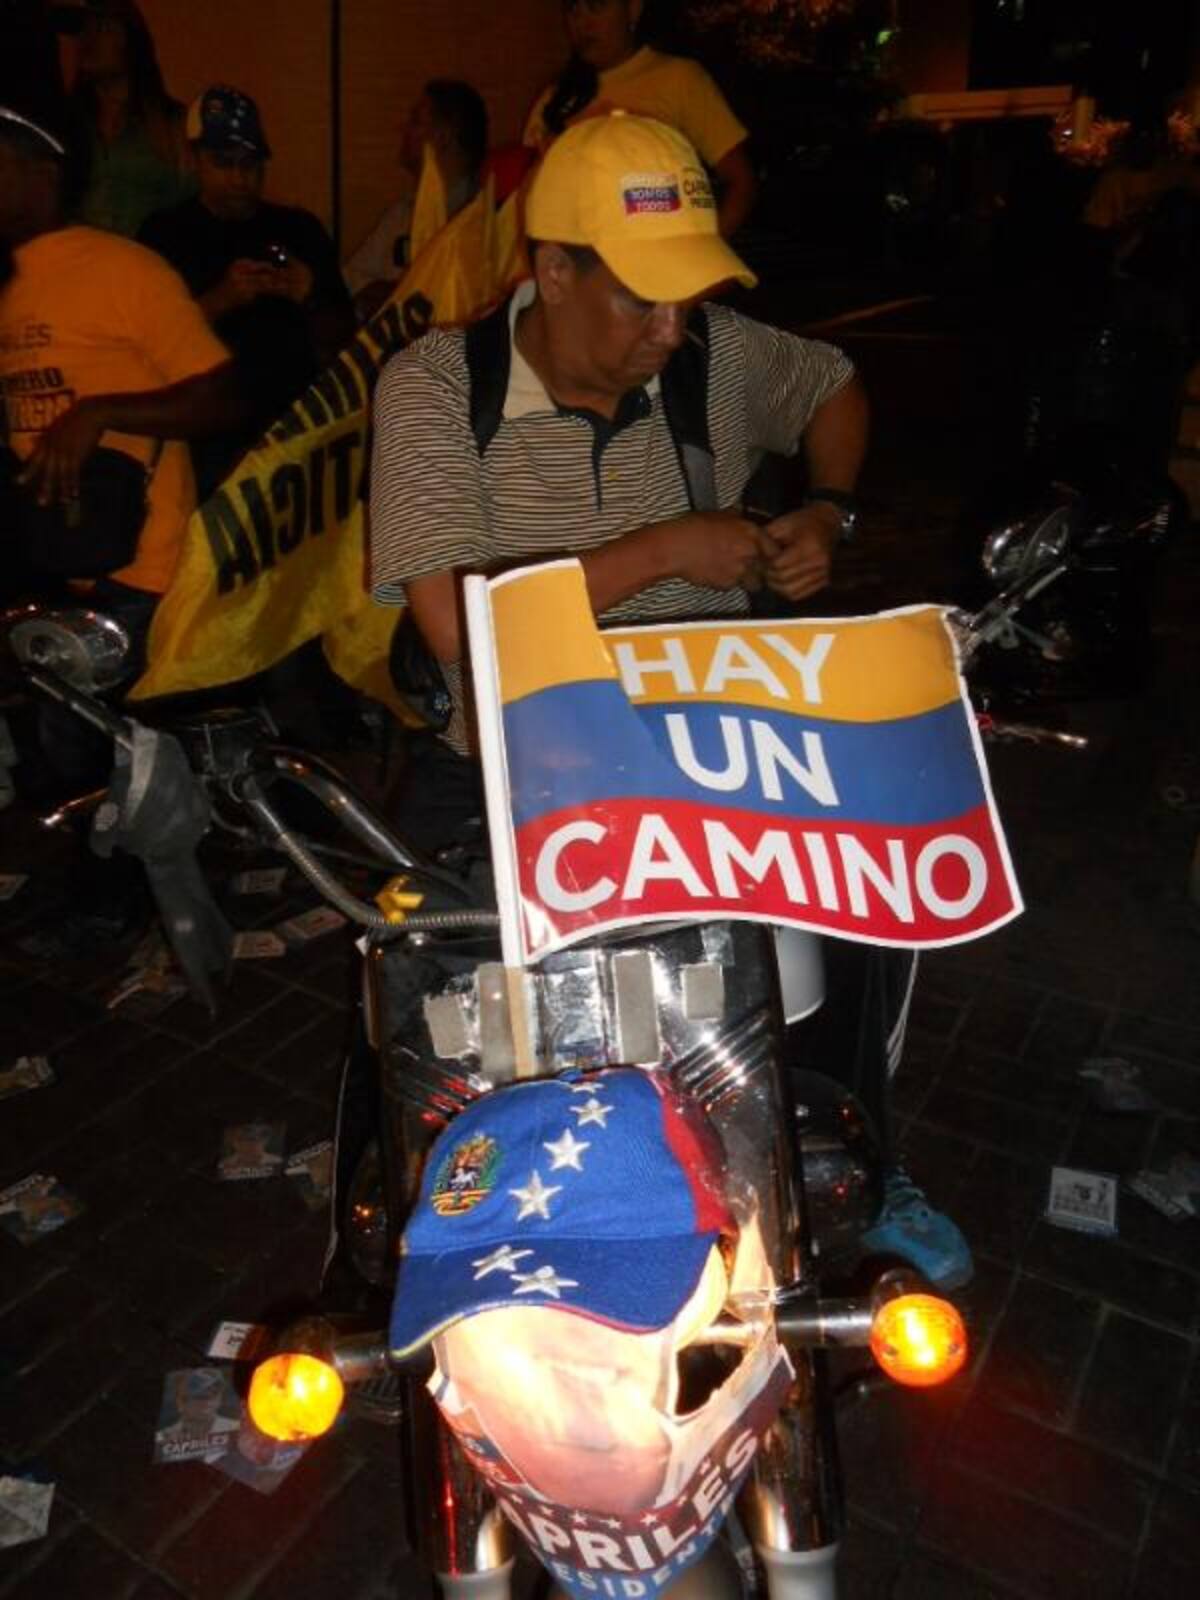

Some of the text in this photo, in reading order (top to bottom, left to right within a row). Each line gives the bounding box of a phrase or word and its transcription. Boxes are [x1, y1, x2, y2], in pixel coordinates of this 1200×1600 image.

[613, 633, 837, 704] HAY
[664, 713, 840, 806] UN
[535, 813, 988, 923] CAMINO
[499, 1427, 758, 1572] APRILES
